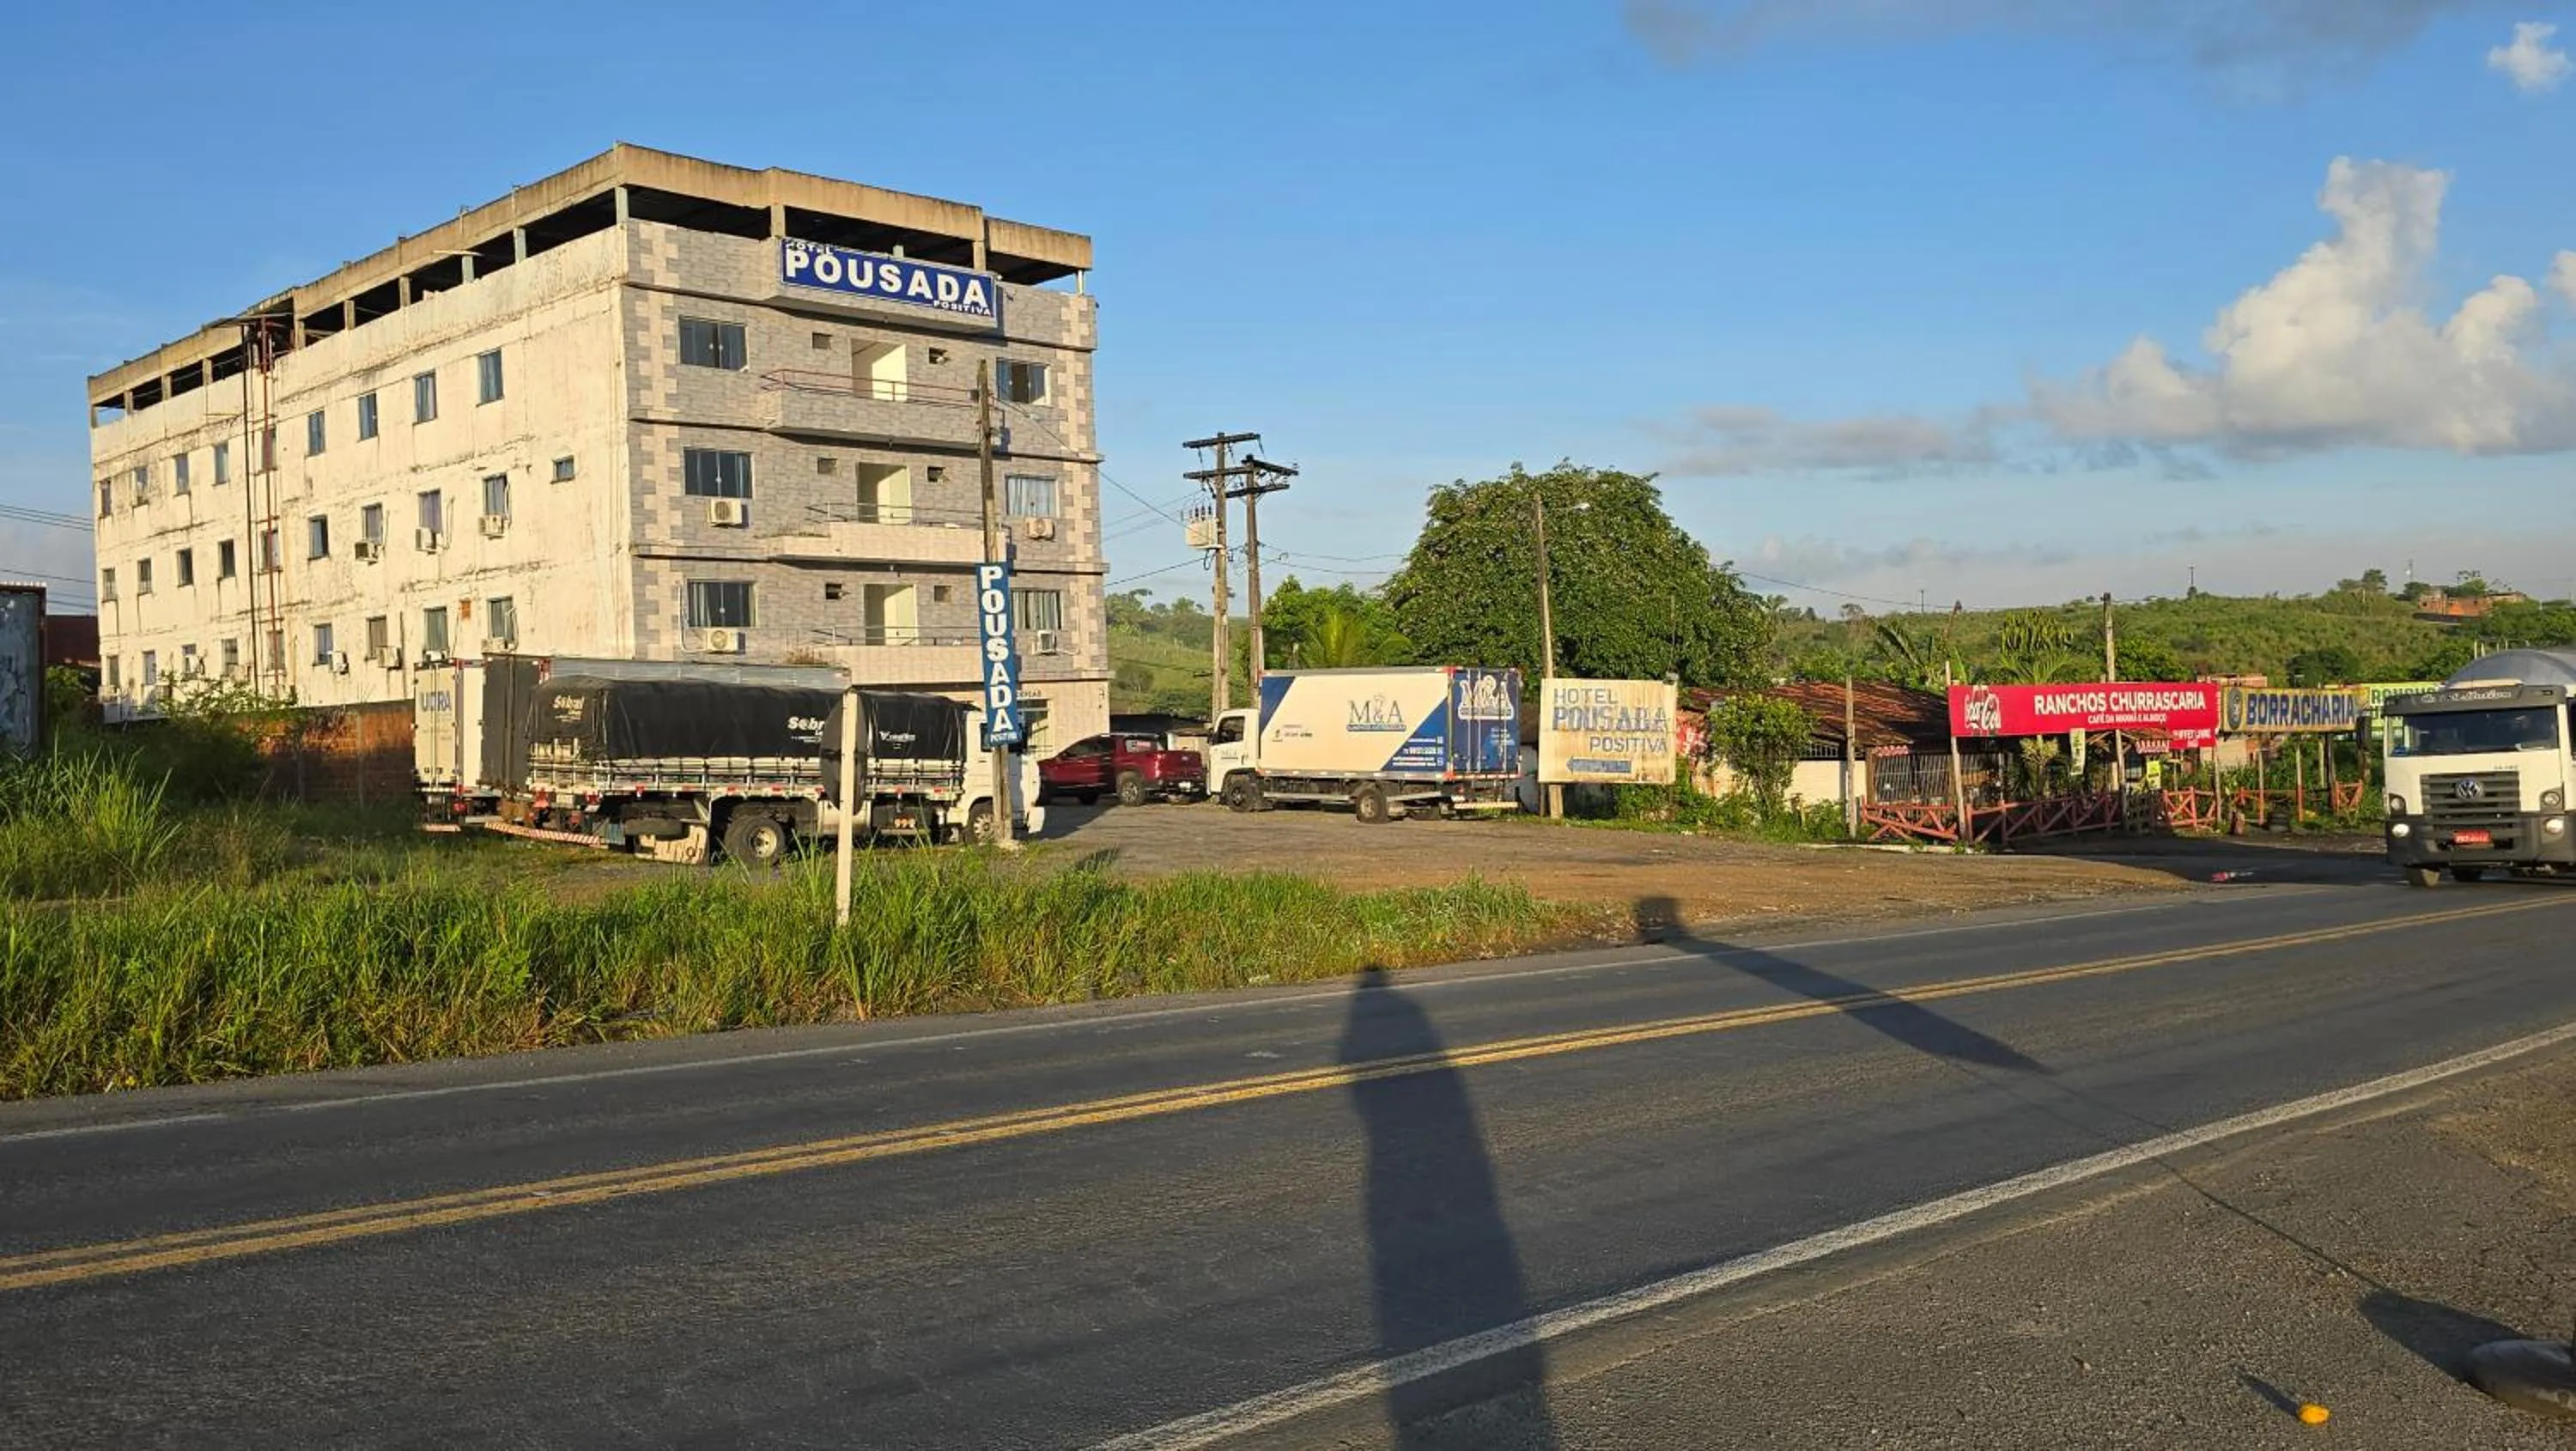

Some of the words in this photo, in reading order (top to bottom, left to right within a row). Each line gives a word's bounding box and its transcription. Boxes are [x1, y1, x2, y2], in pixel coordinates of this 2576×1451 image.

[786, 249, 988, 307] POUSADA
[933, 300, 991, 317] POSITIVA
[980, 566, 1014, 733] POUSADA
[1553, 688, 1619, 705] HOTEL
[2034, 692, 2106, 715] RANCHOS
[2110, 690, 2207, 713] CHURRASCARIA
[2246, 693, 2355, 725] BORRACHARIA
[1552, 706, 1669, 732] POUSADA
[1590, 736, 1668, 753] POSITIVA
